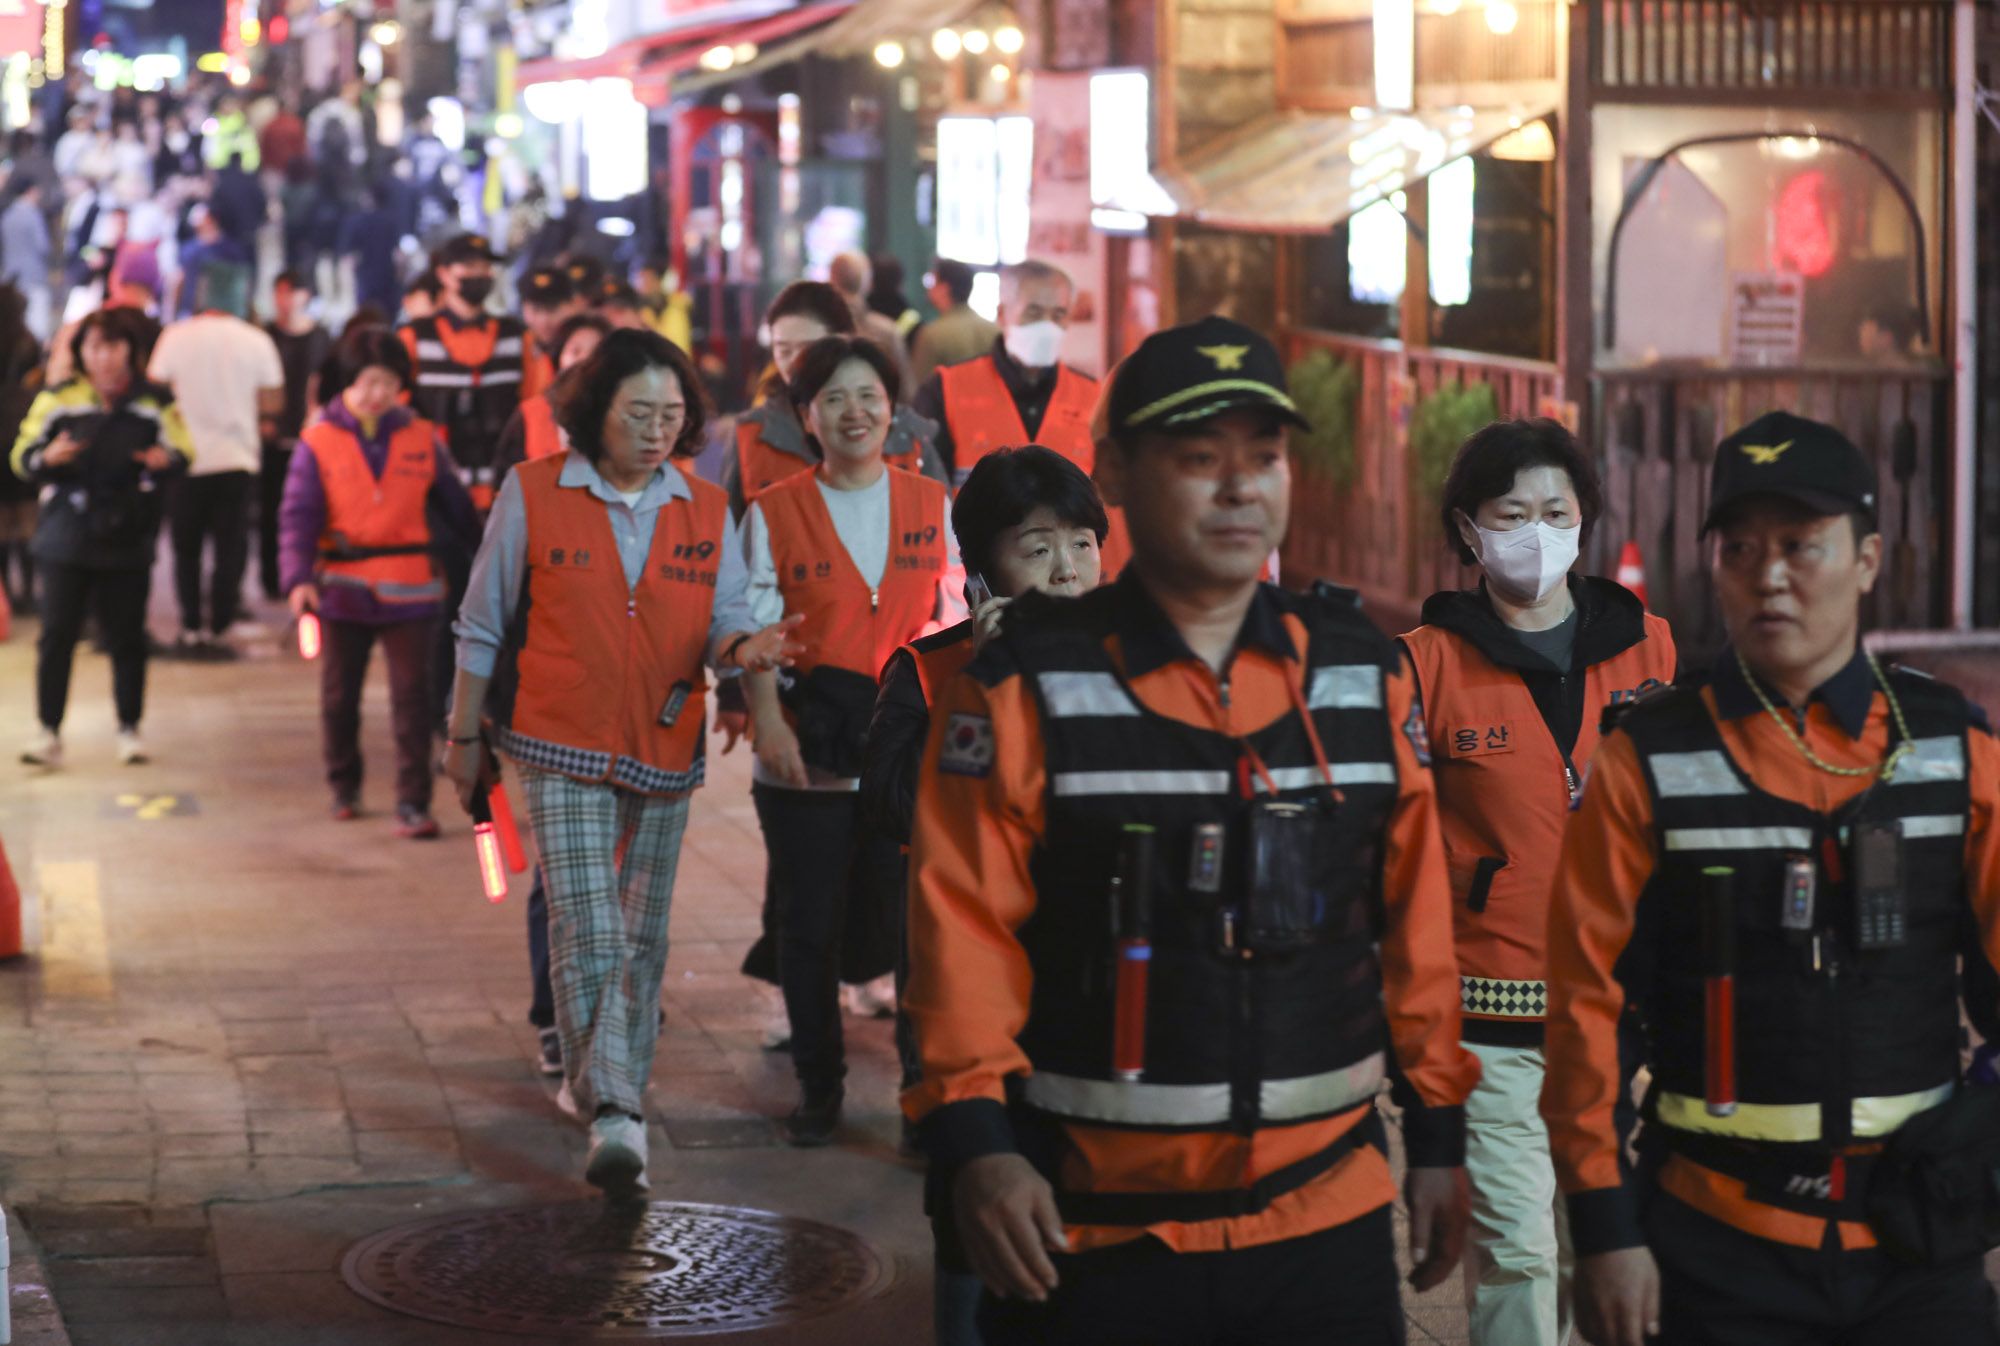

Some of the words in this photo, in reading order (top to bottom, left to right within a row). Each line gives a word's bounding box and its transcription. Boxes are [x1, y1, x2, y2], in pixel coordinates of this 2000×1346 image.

[903, 525, 937, 547] 119
[672, 540, 715, 561] 119
[1454, 725, 1509, 752] 용산
